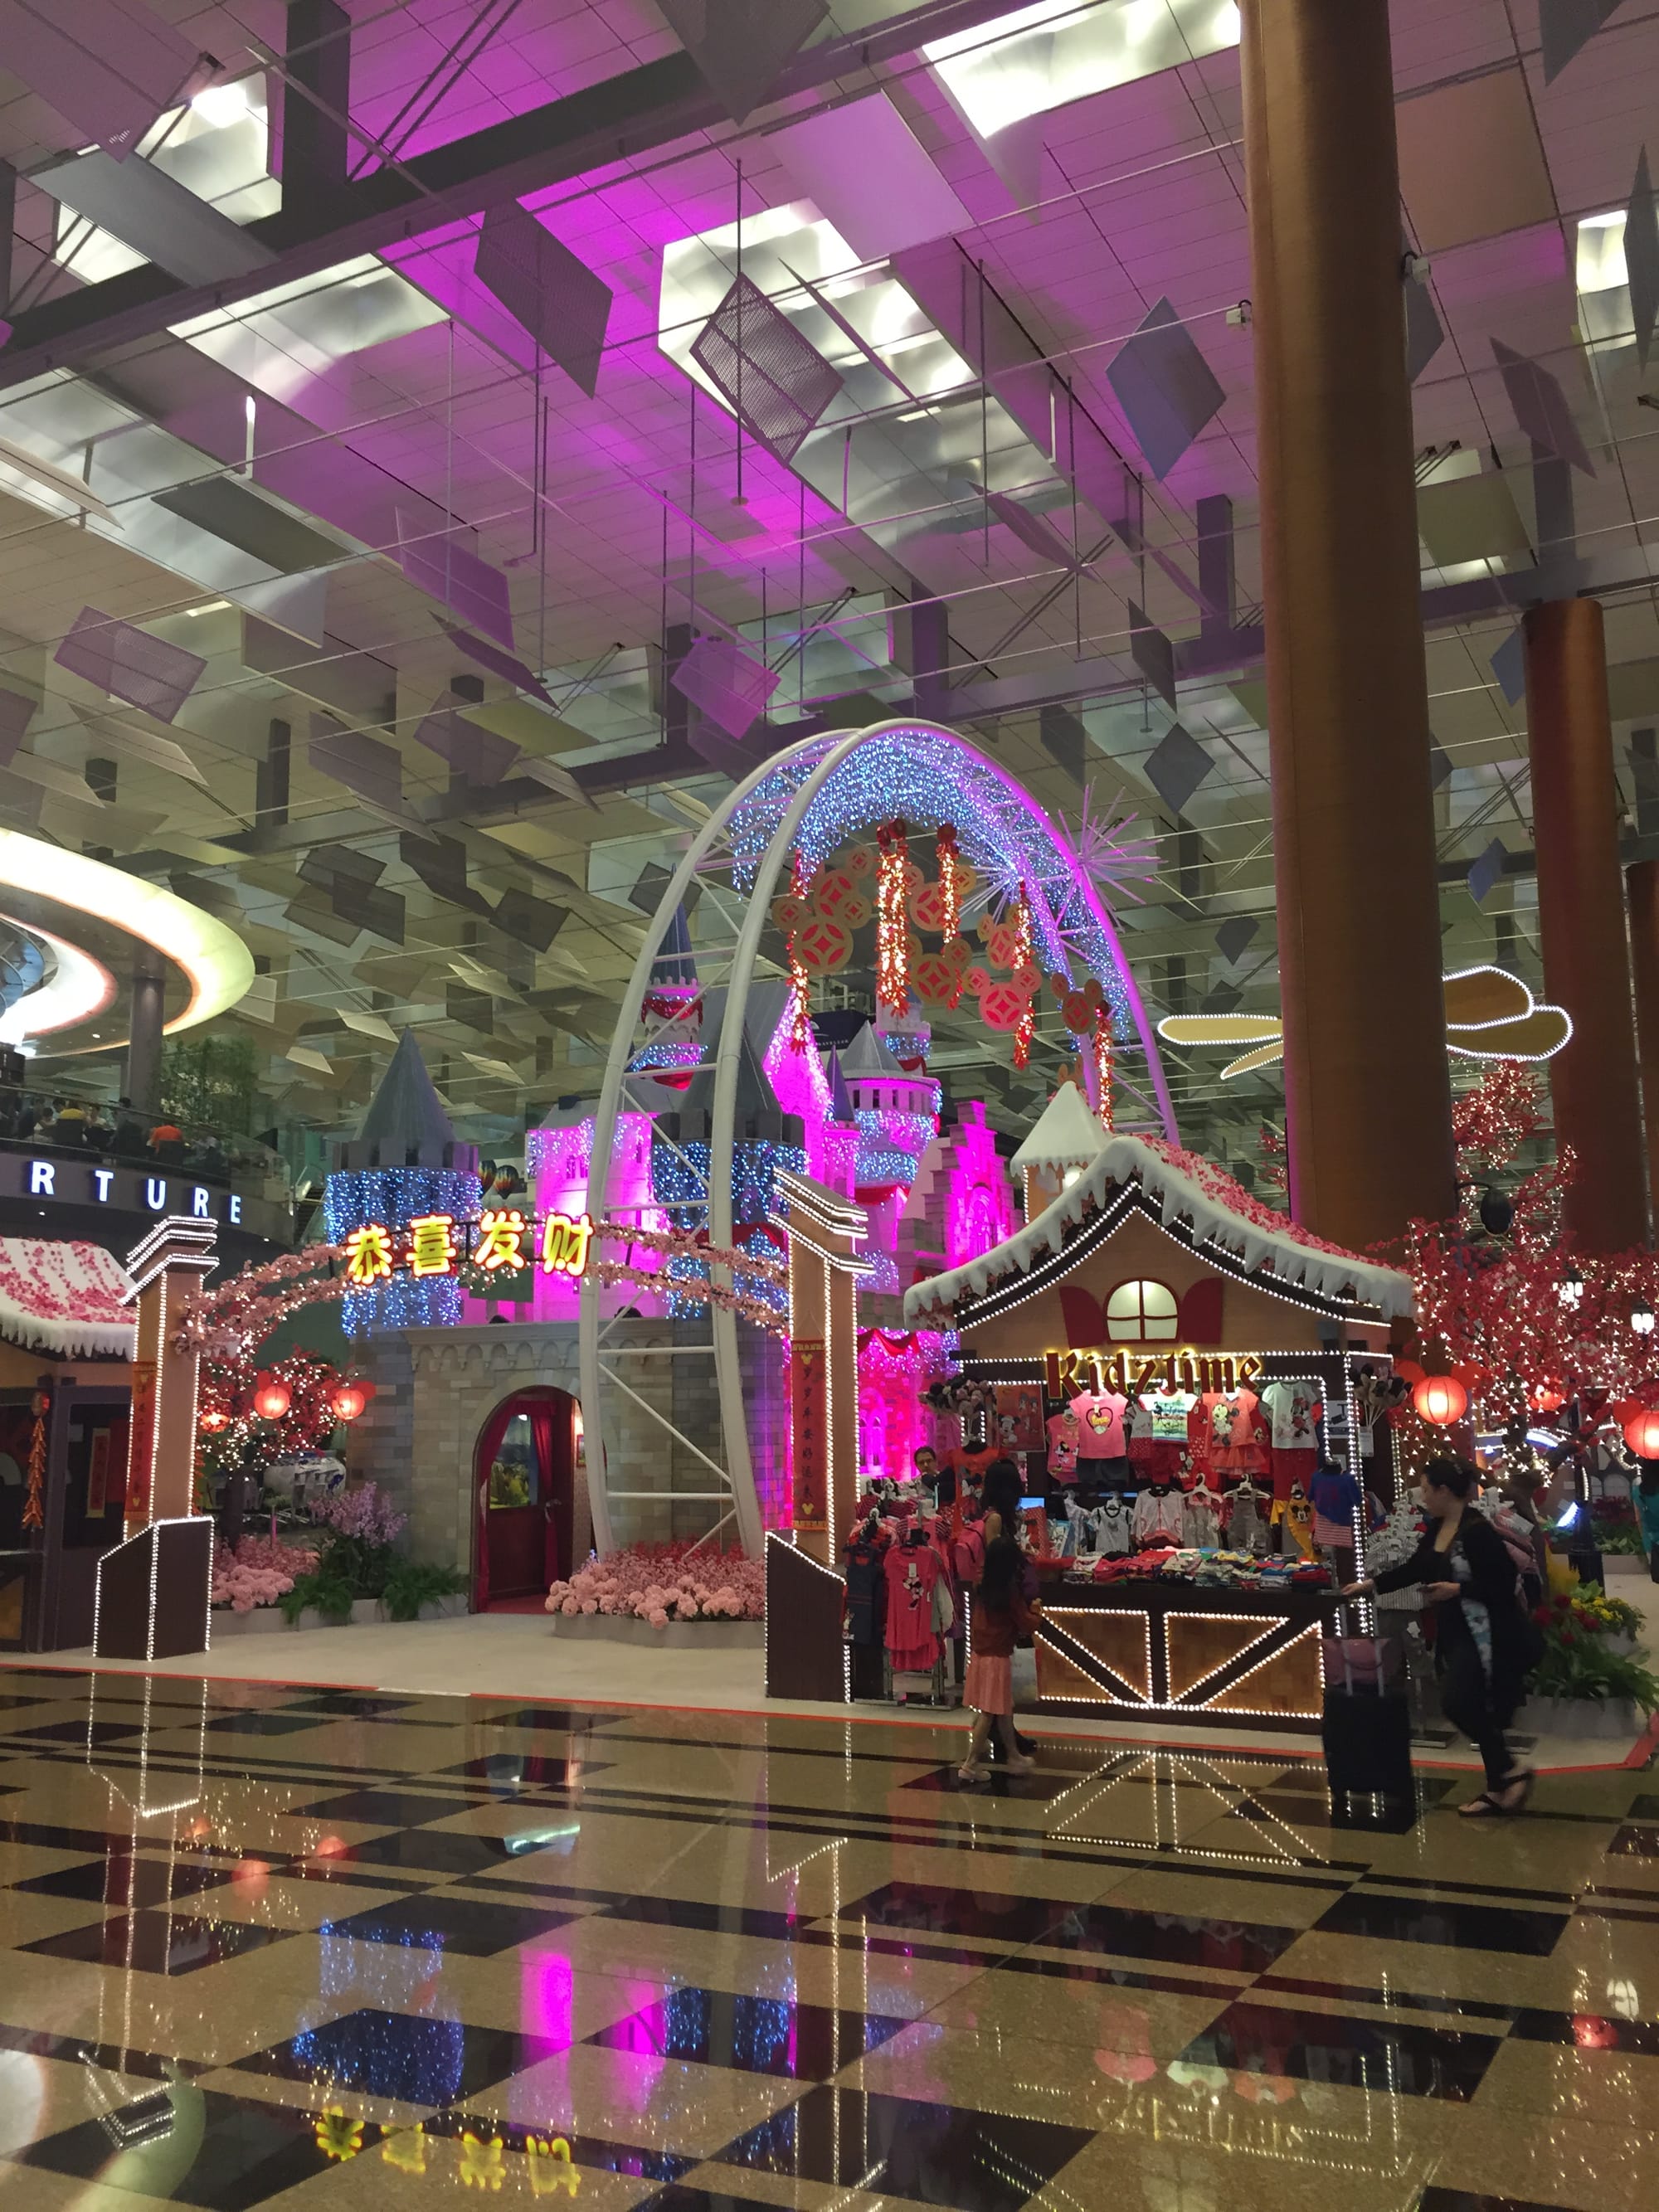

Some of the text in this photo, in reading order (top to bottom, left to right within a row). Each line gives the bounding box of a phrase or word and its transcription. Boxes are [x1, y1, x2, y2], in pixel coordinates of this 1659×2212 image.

[29, 1160, 242, 1224] RTURE
[344, 1207, 596, 1285] 恭喜发财
[1046, 1349, 1261, 1399] Kidztime
